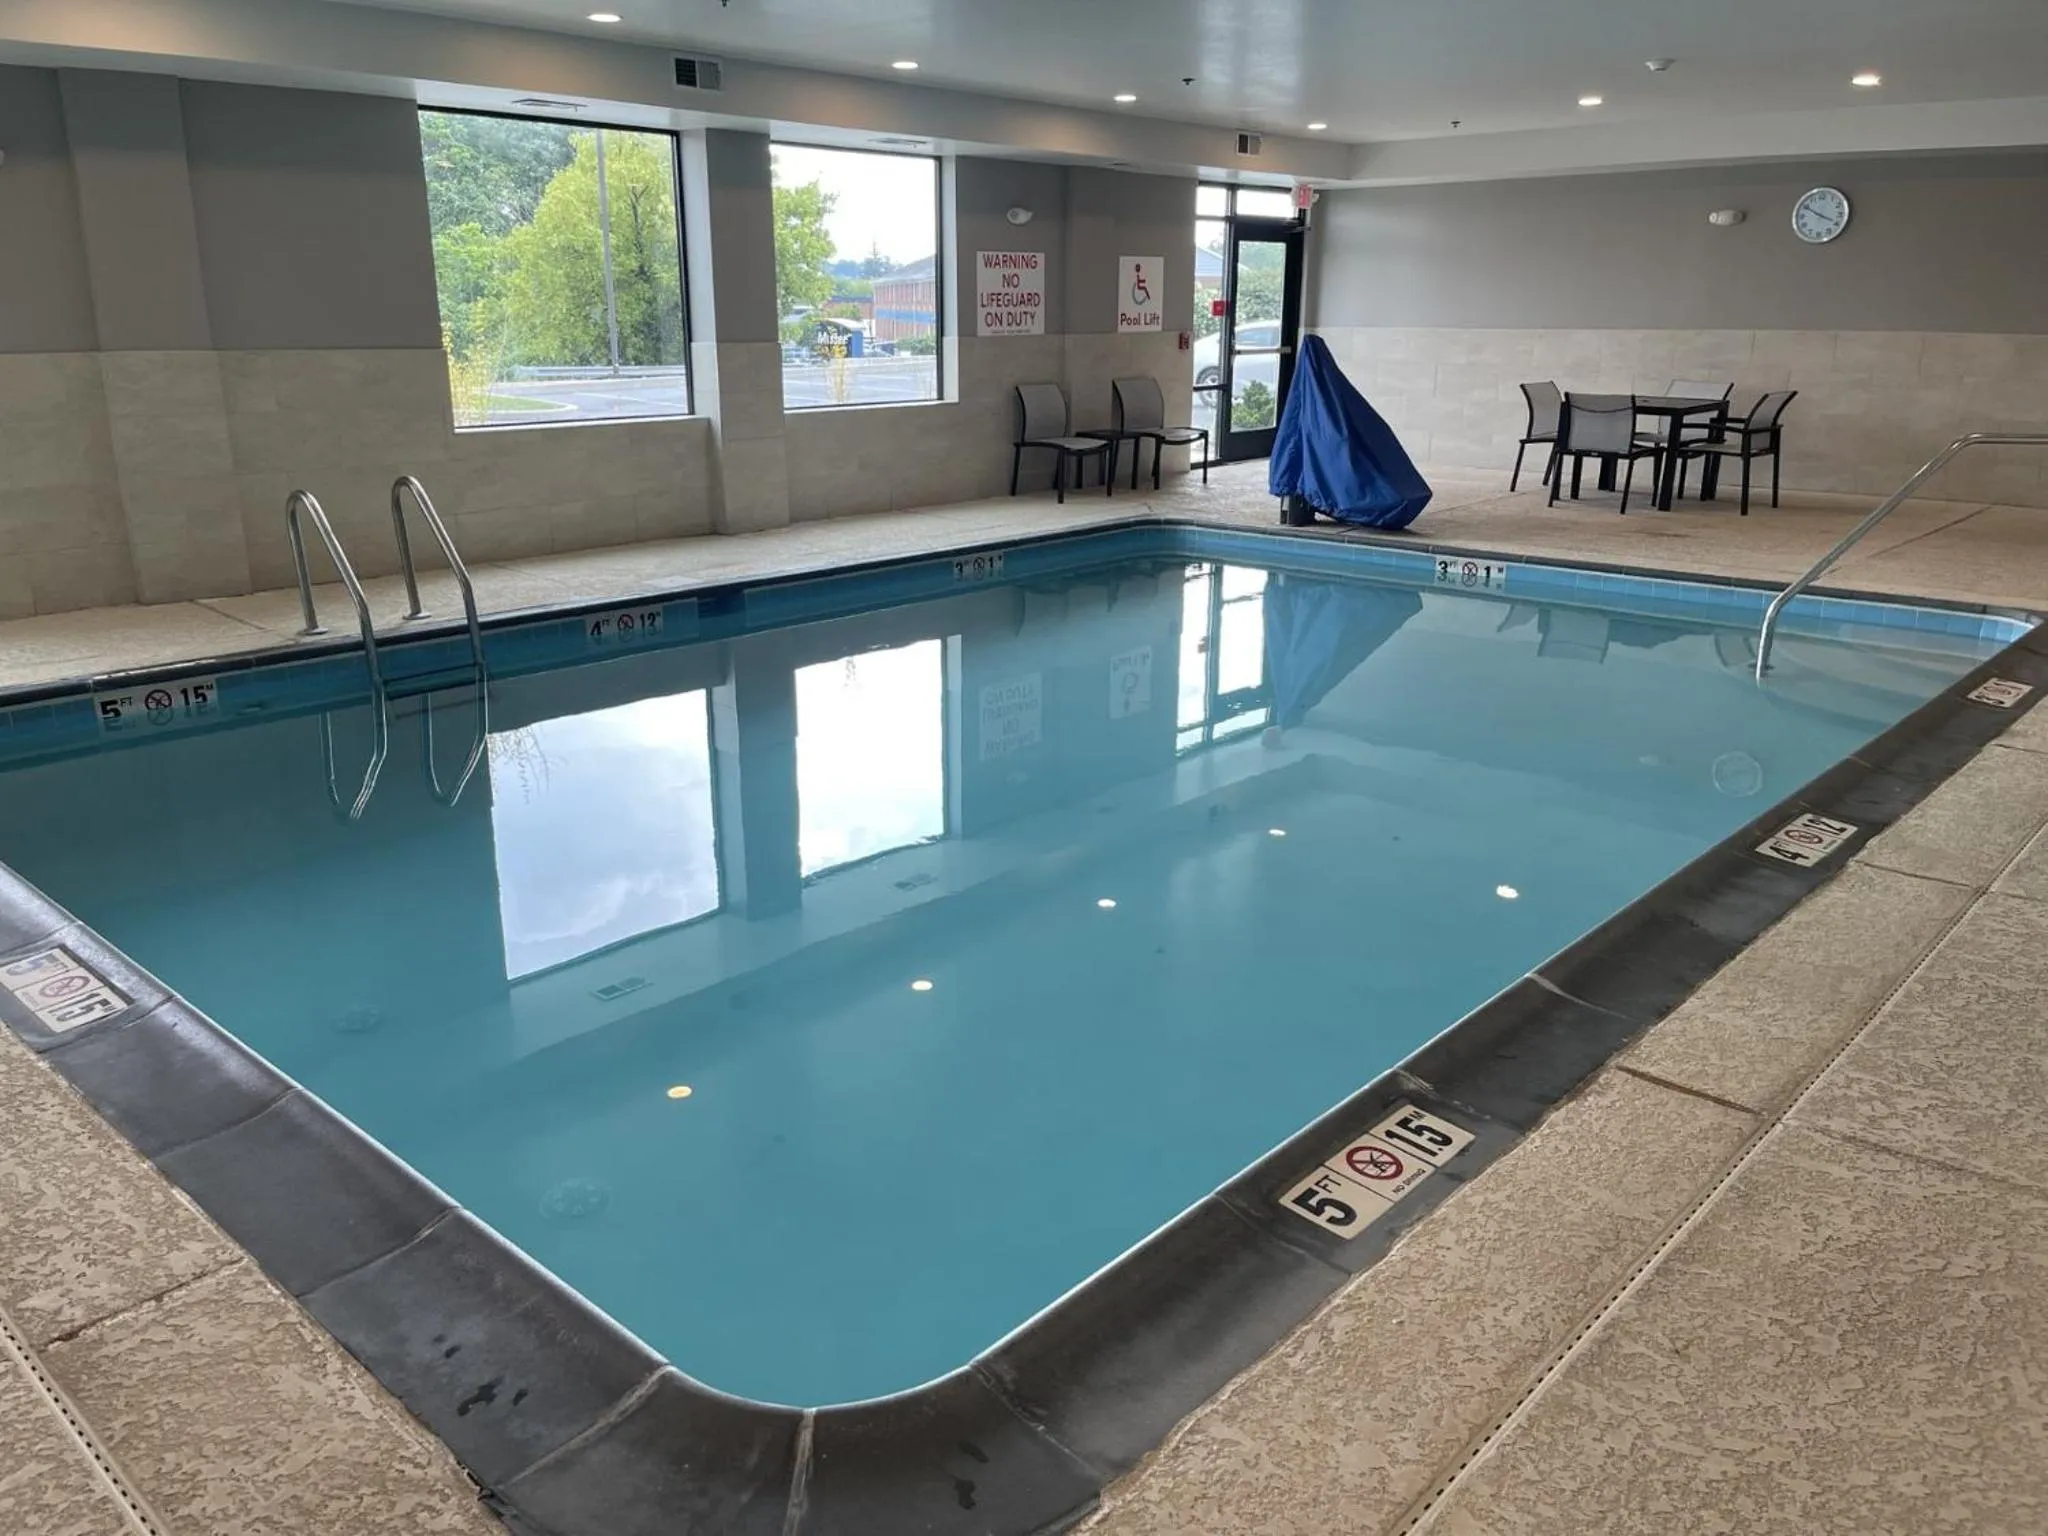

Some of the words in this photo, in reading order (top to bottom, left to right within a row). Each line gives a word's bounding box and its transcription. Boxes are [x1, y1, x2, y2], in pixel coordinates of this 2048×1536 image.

[983, 254, 1038, 269] WARNING
[1002, 273, 1020, 288] NO
[981, 293, 1041, 308] LIFEGUARD
[985, 312, 1003, 327] ON
[1007, 311, 1036, 326] DUTY
[1120, 313, 1140, 326] Pool
[1144, 312, 1160, 325] Lift
[1392, 1184, 1405, 1194] NO
